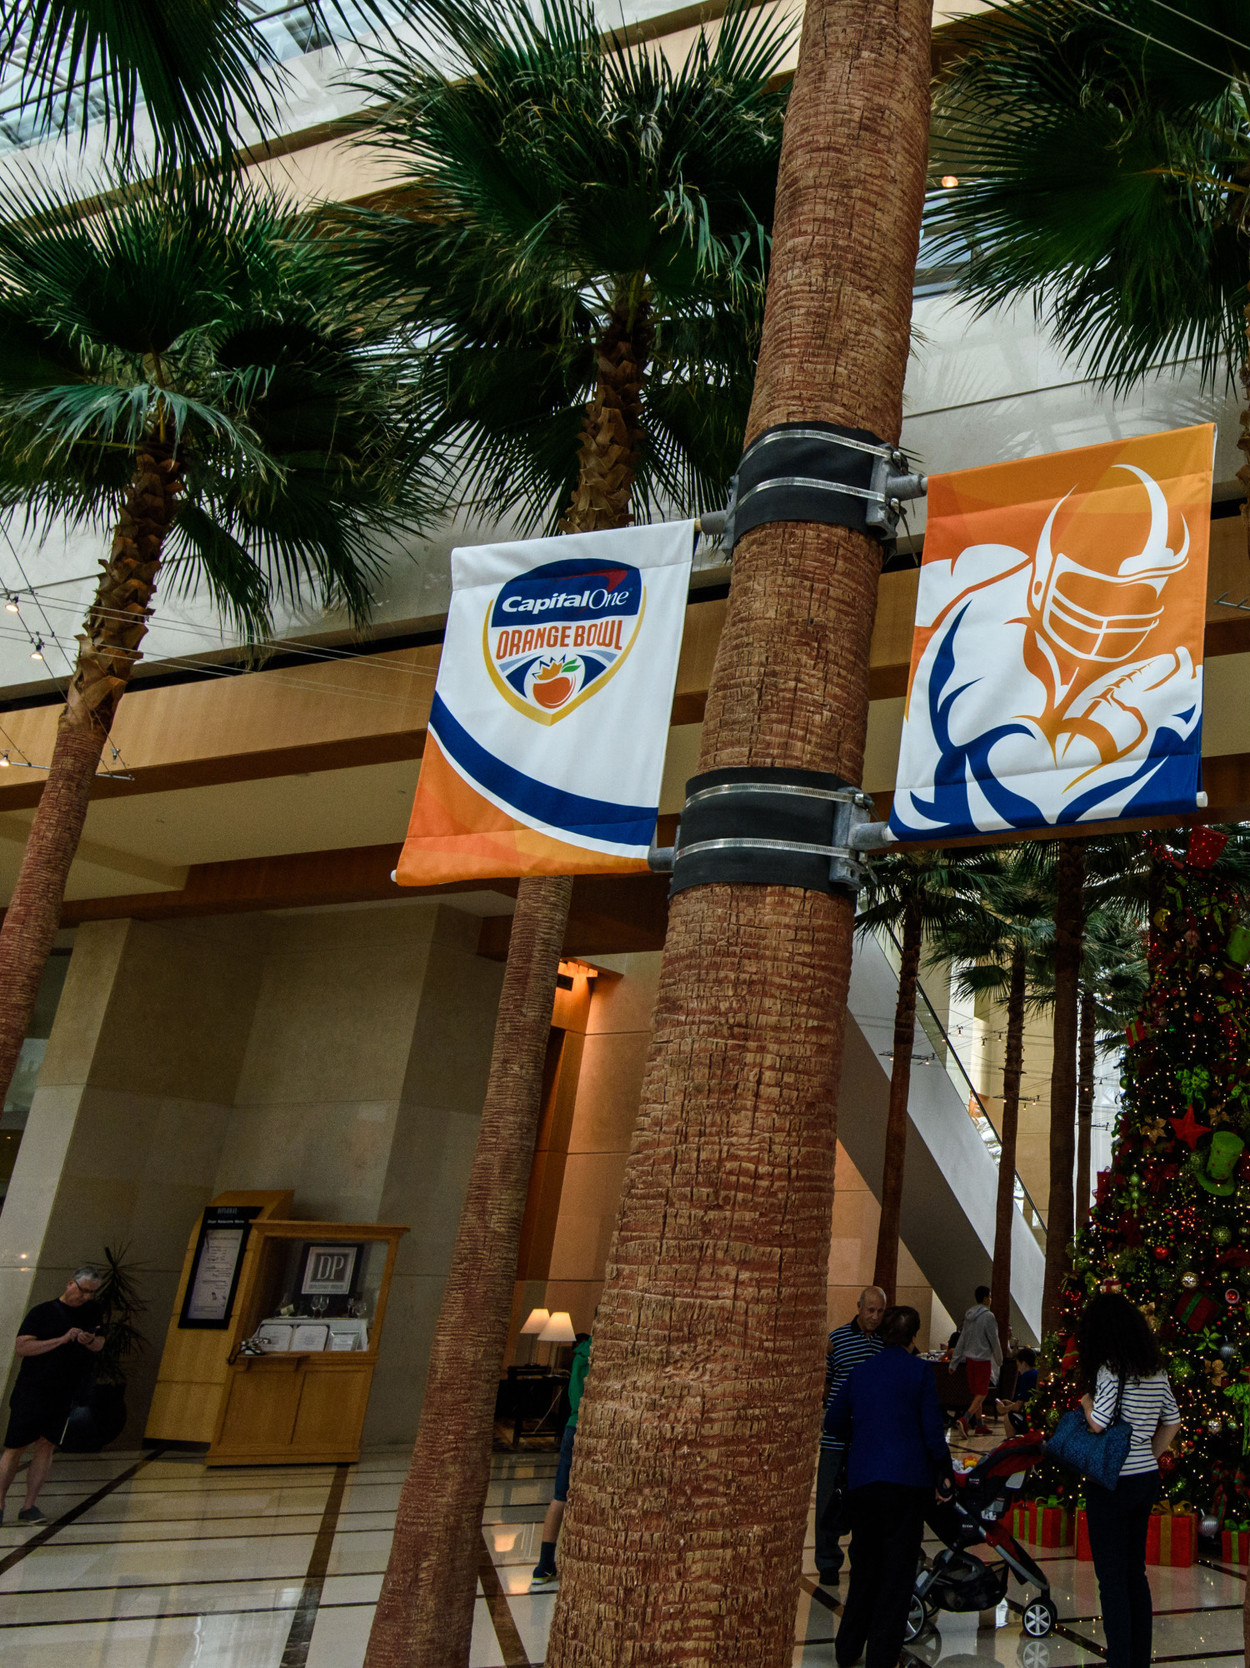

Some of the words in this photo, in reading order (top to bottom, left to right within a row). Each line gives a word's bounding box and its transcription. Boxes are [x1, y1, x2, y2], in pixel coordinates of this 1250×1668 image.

[495, 625, 572, 660] ORANGE
[573, 620, 623, 651] BOWL
[316, 1255, 345, 1280] DP
